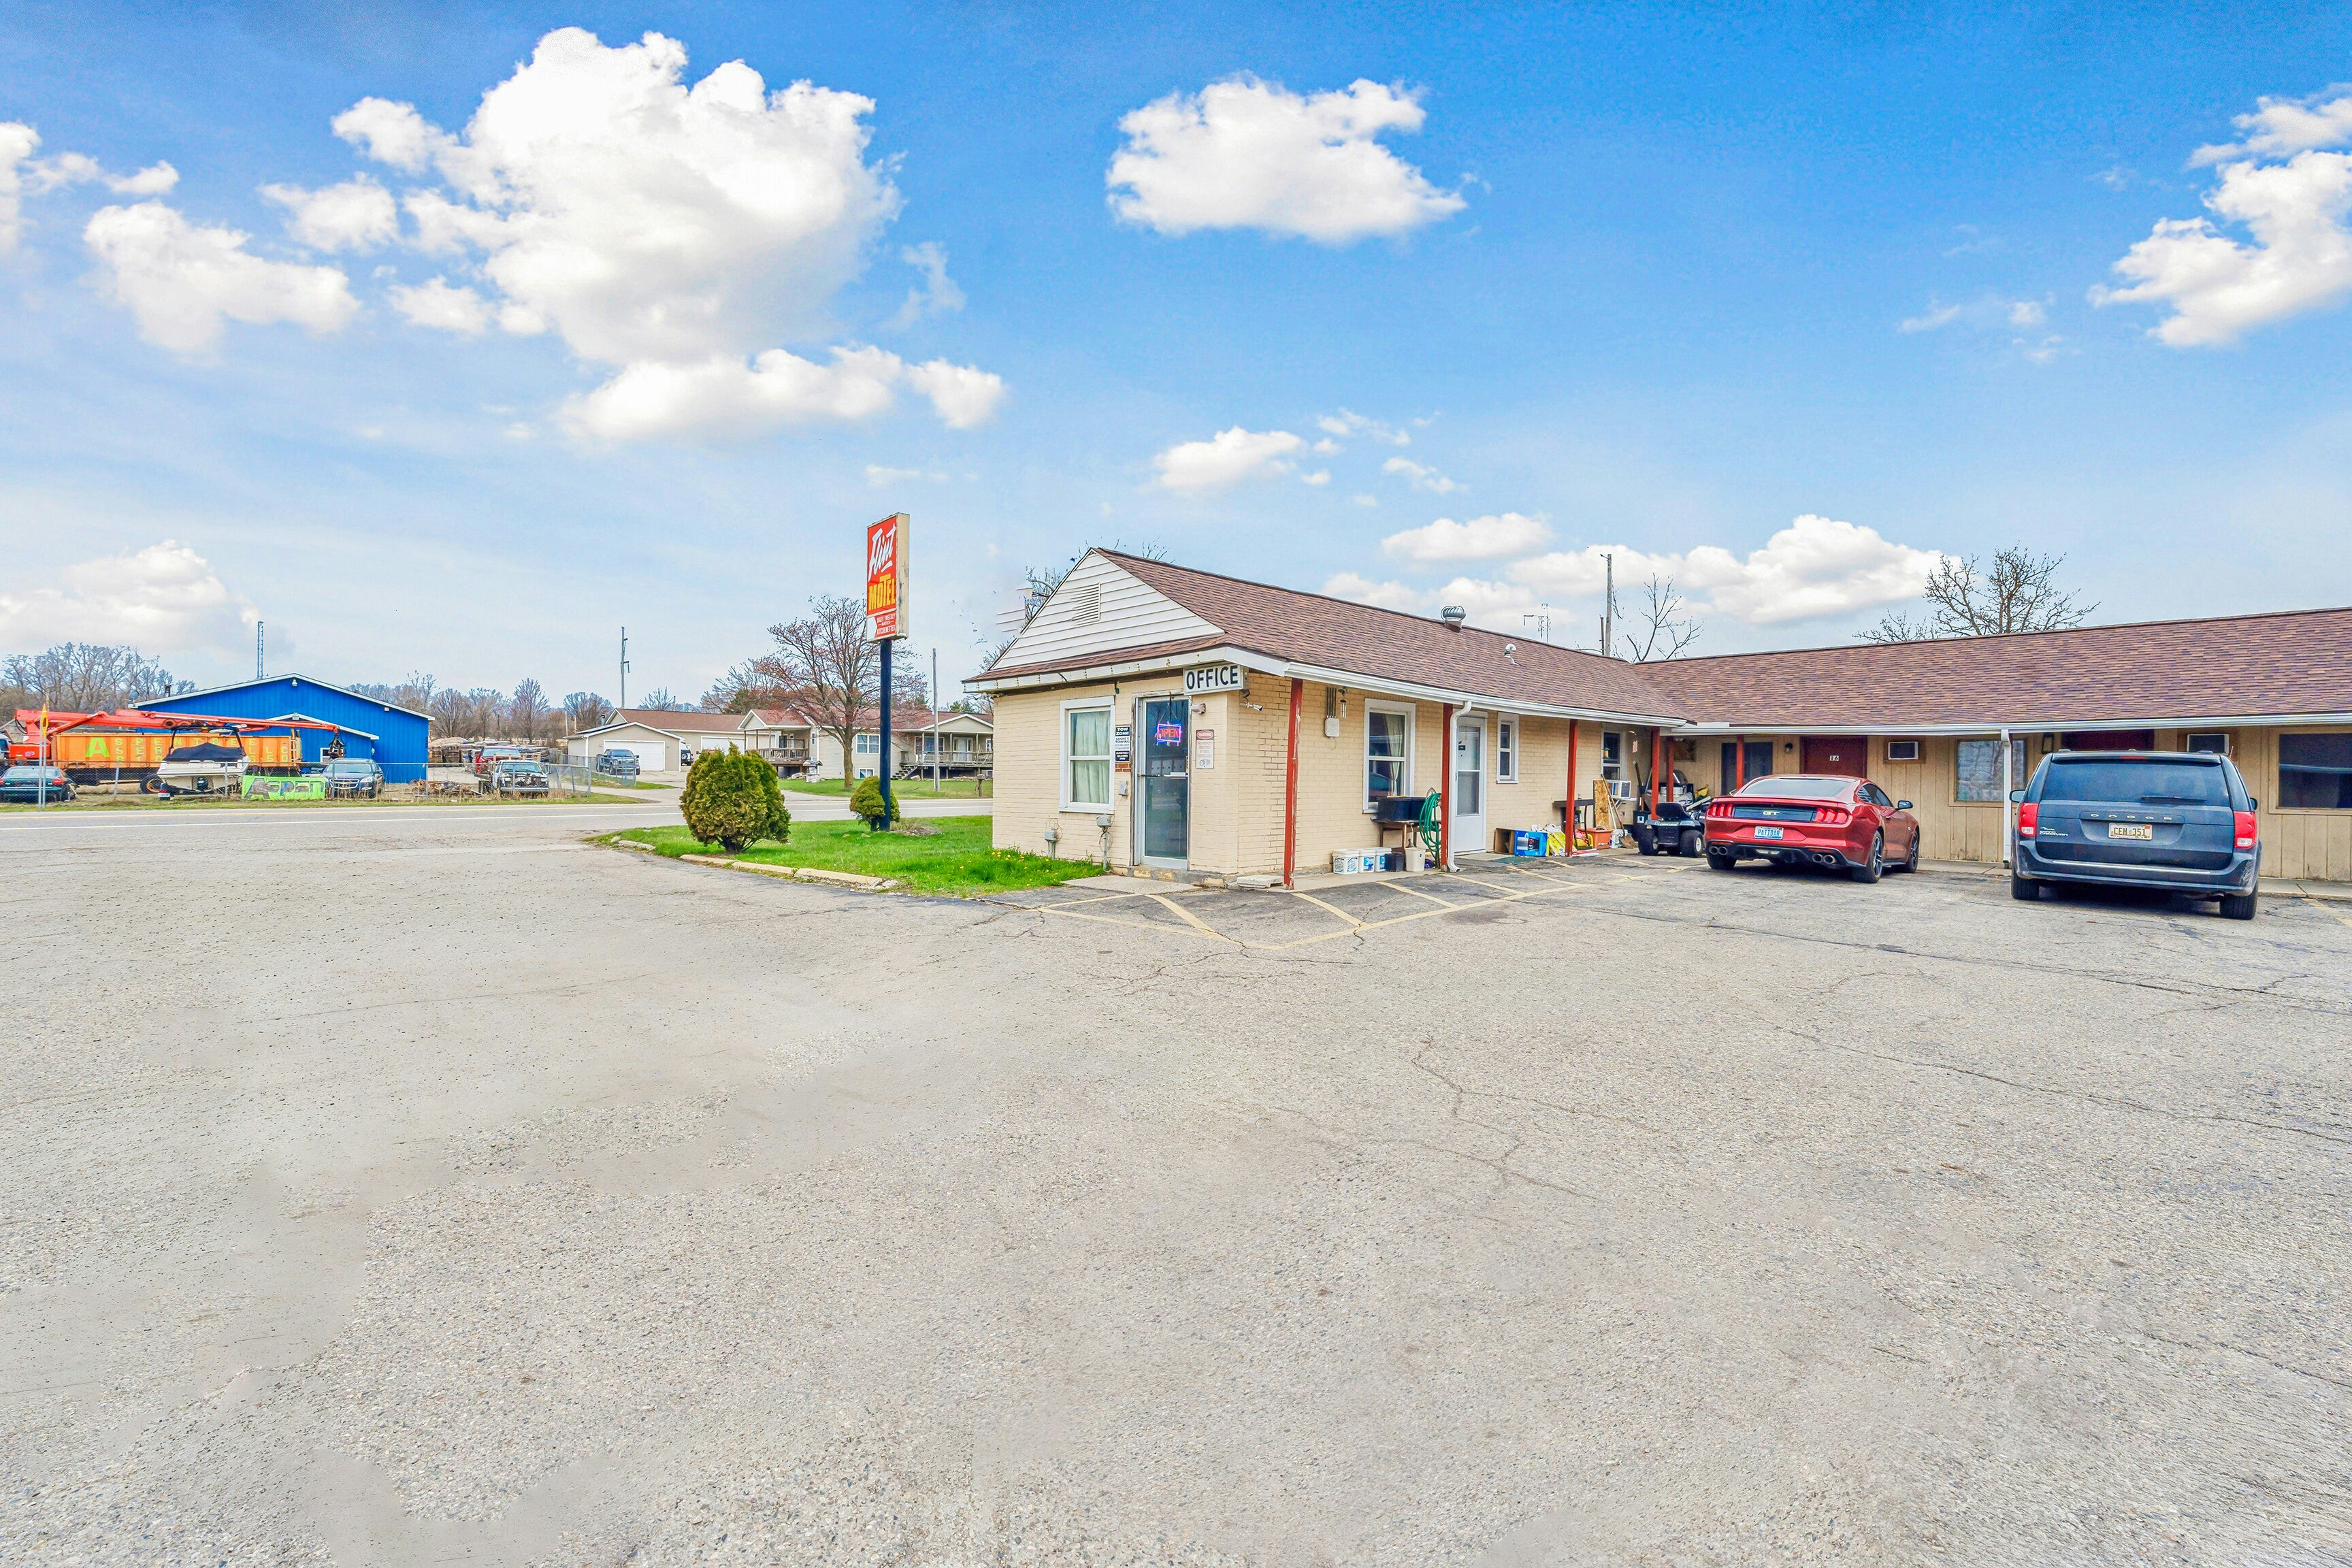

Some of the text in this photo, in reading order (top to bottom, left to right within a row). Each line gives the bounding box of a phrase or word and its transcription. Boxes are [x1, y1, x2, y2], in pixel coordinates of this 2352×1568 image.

[868, 574, 896, 611] MOTEL
[1186, 665, 1239, 690] OFFICE
[1158, 728, 1179, 738] OPEN
[2114, 828, 2146, 836] CEH 351
